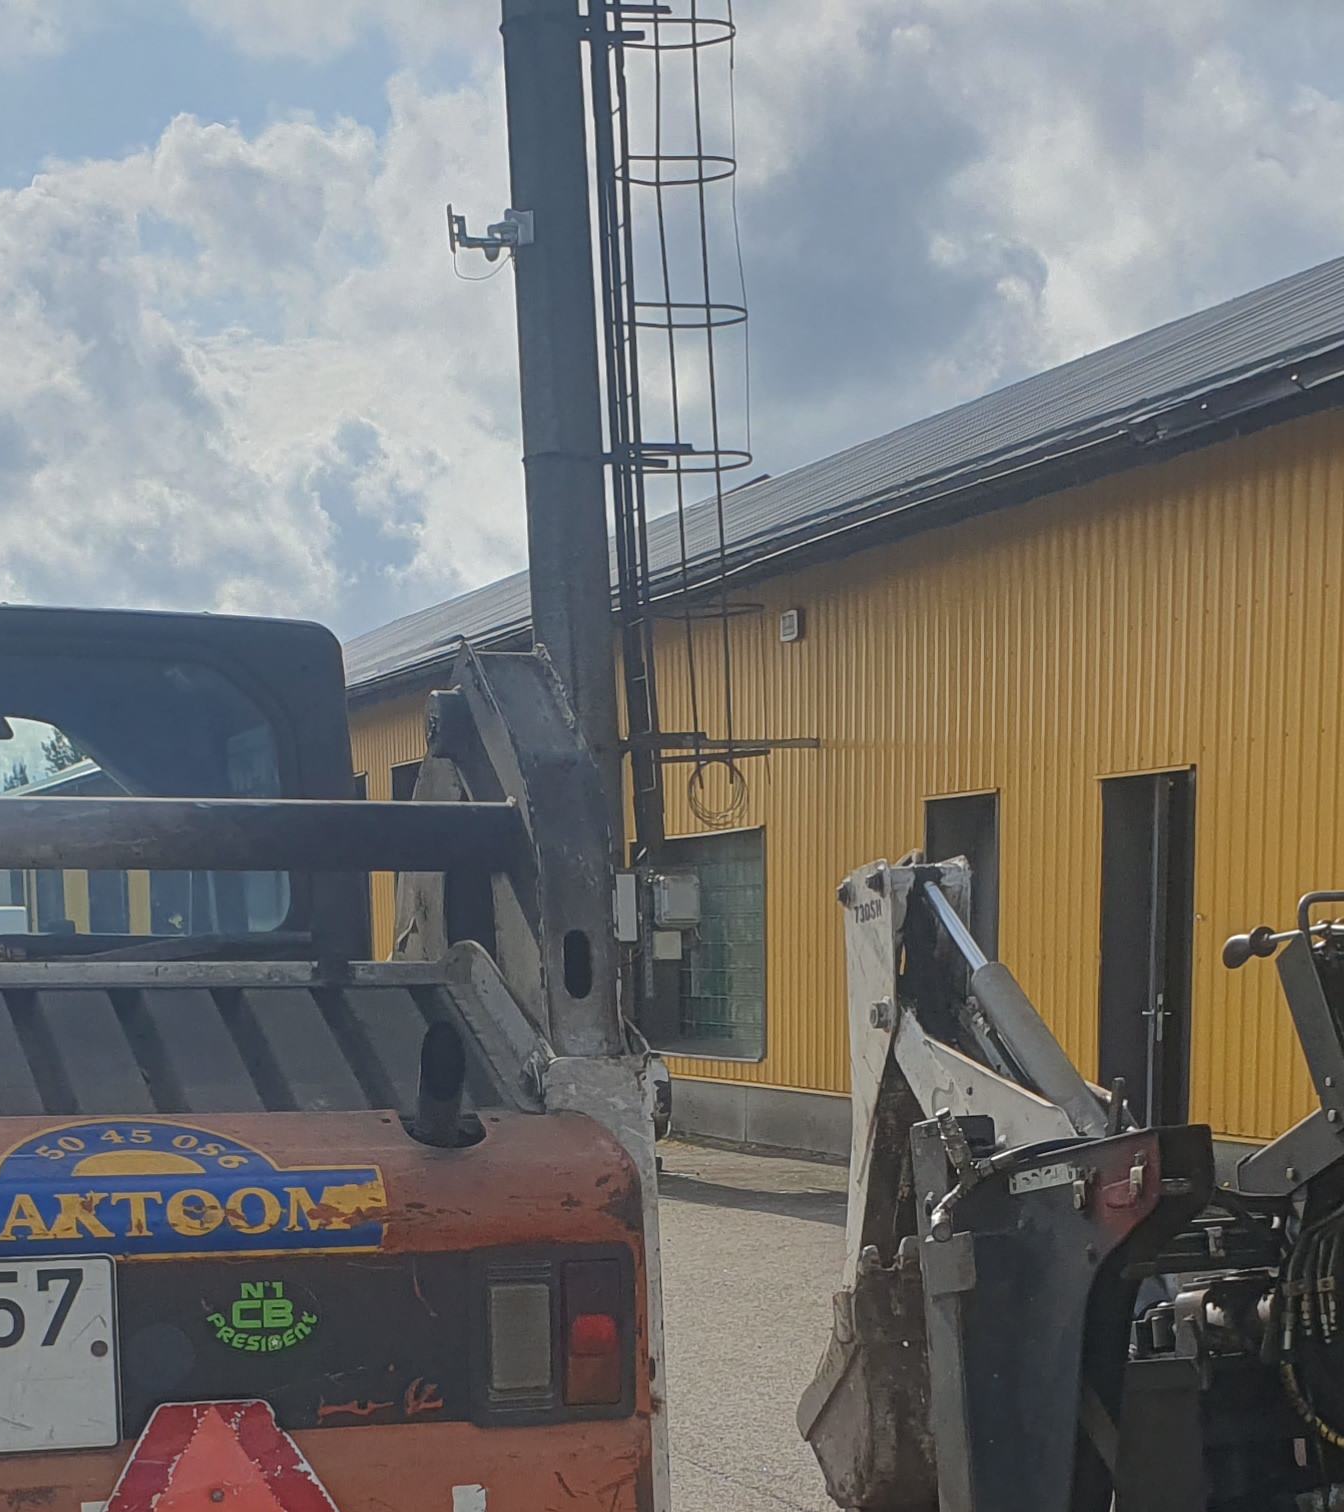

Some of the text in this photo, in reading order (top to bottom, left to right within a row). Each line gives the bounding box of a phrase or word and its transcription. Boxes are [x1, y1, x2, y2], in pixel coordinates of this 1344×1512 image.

[35, 1135, 86, 1161] 50
[100, 1129, 154, 1145] 45
[232, 1299, 293, 1329] CB
